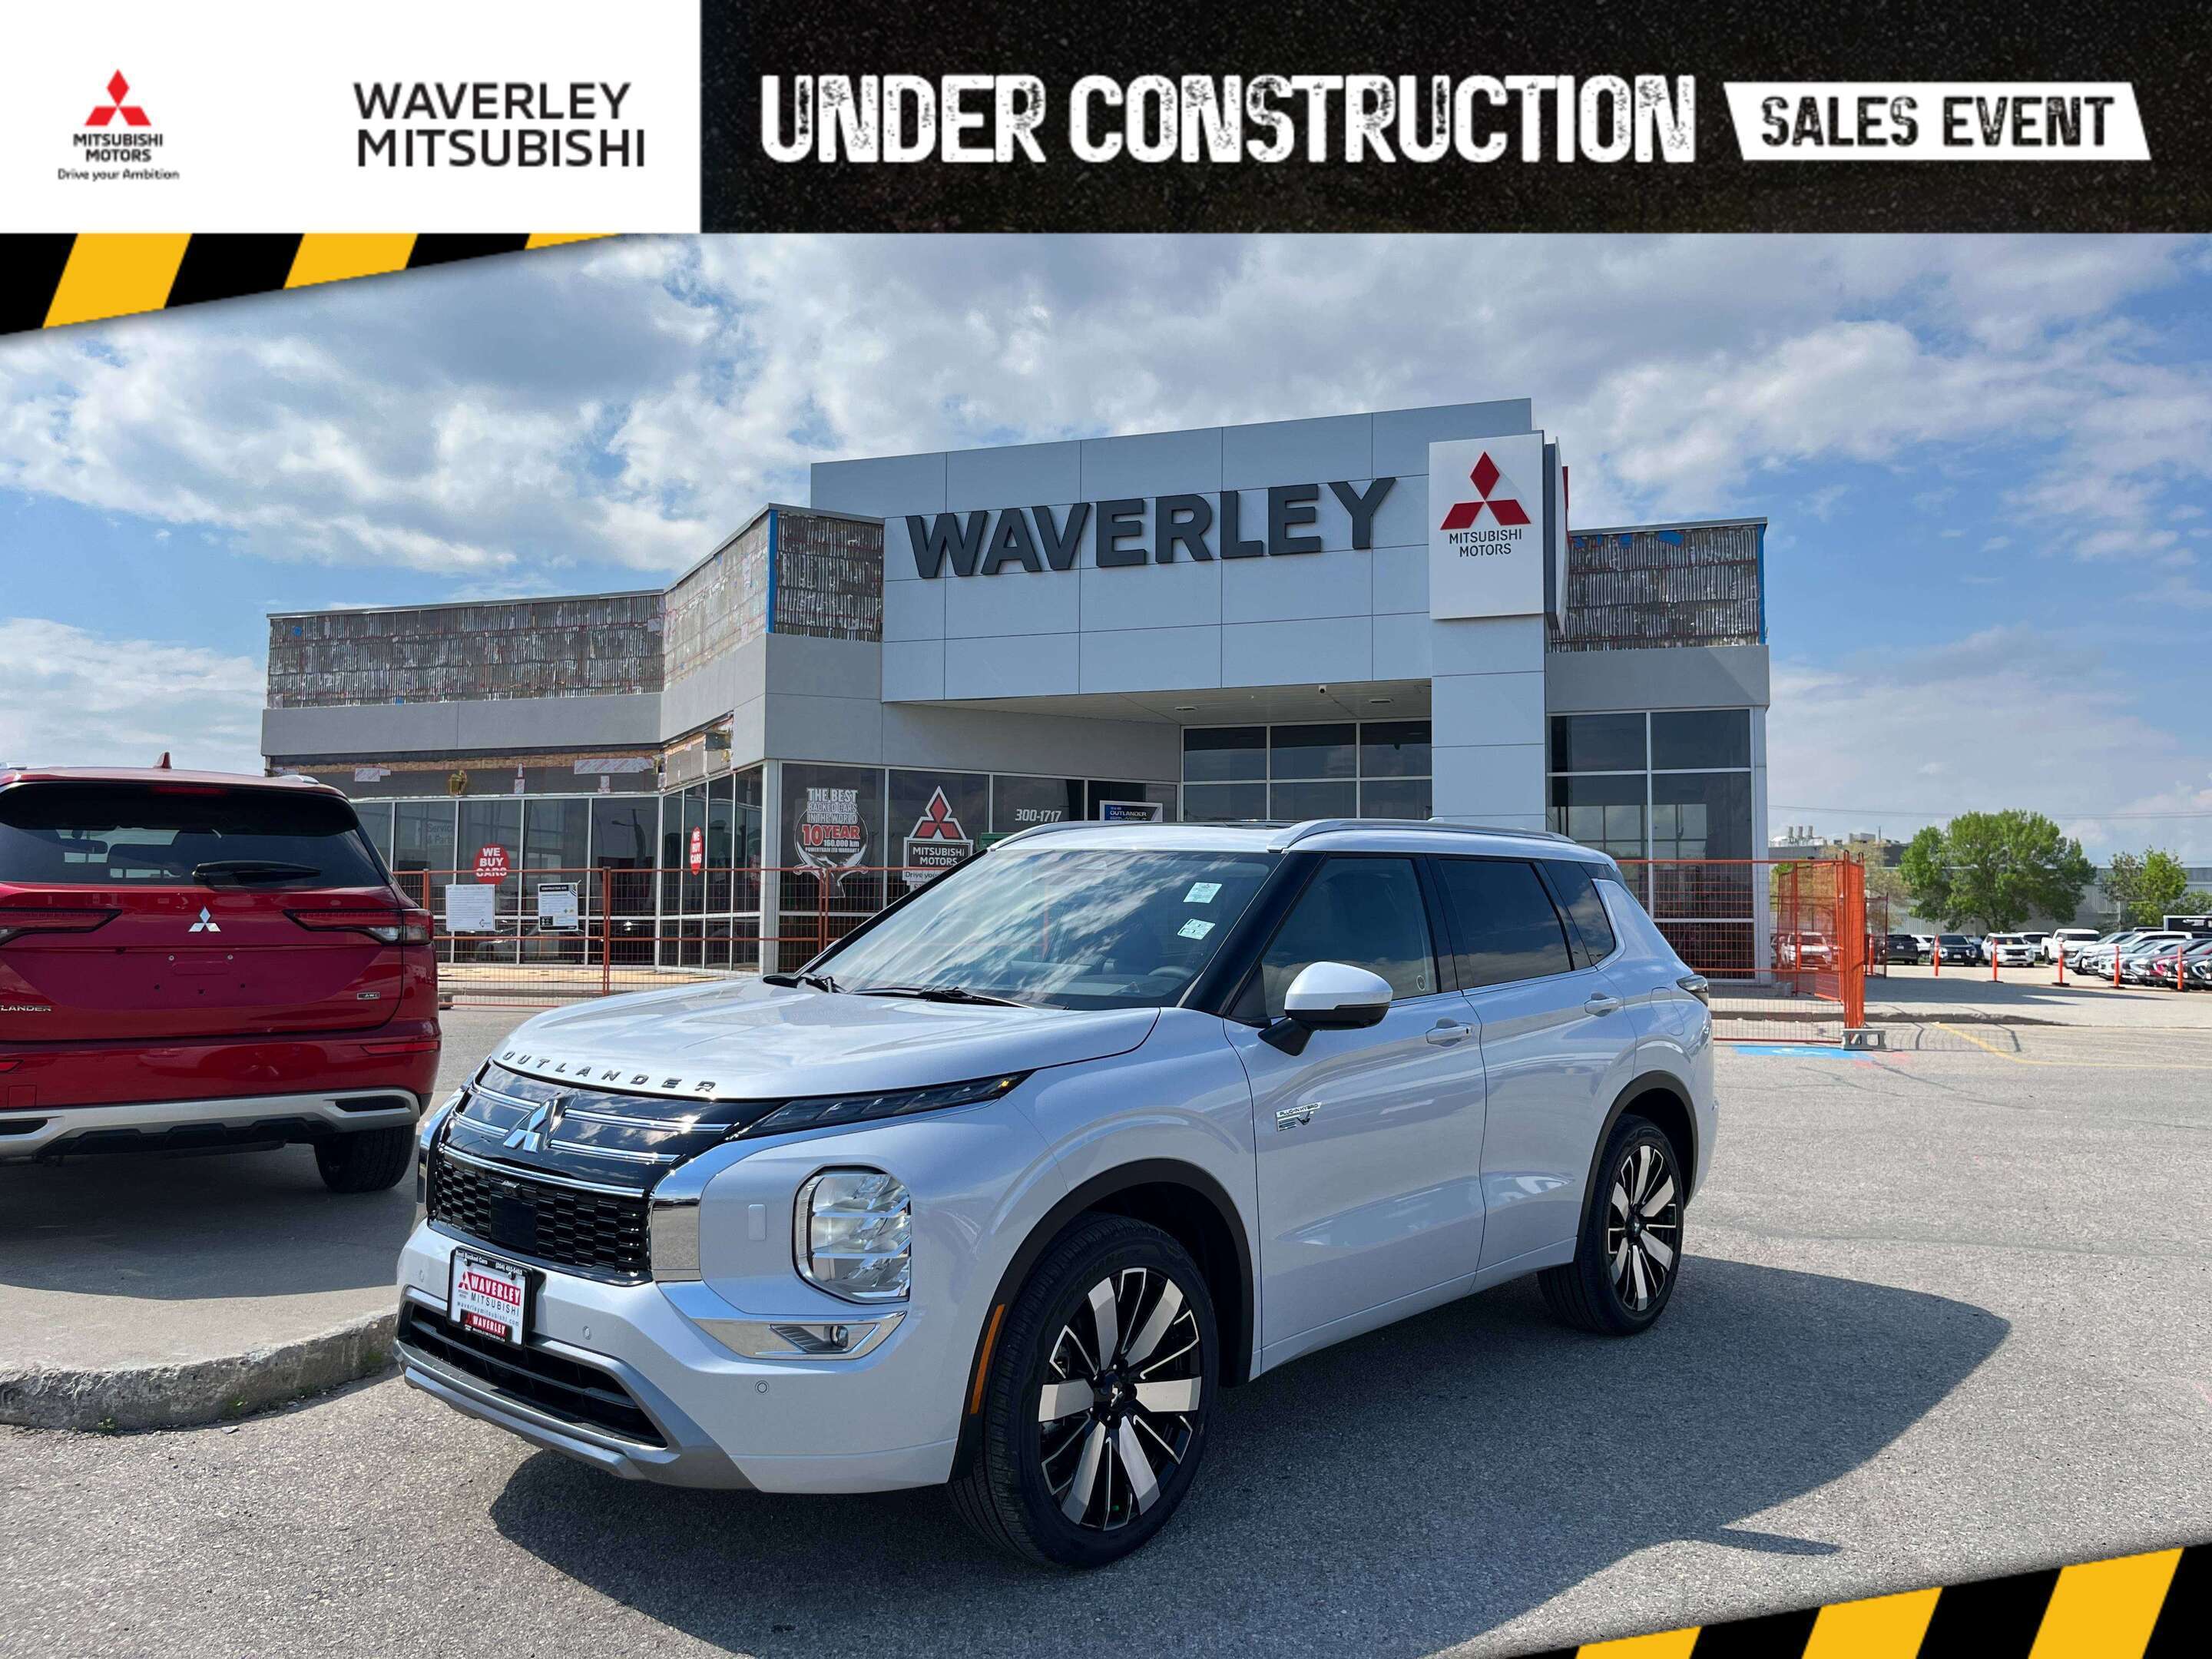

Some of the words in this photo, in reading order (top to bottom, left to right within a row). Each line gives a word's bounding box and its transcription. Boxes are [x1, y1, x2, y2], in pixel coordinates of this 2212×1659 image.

[906, 477, 1396, 579] WAVERLEY
[1449, 528, 1522, 545] MITSUBISHI
[1459, 543, 1512, 558] MOTORS
[807, 788, 828, 802] THE
[830, 790, 858, 803] BEST
[808, 802, 836, 813] BACKED
[837, 803, 858, 813] CARS
[807, 813, 816, 823] IN
[816, 813, 830, 823] THE
[830, 813, 858, 824] WORLD
[1015, 808, 1062, 823] 300-1717
[802, 824, 824, 846] 10
[822, 825, 860, 839] YEAR
[482, 847, 501, 857] WE
[912, 846, 965, 856] MITSUBISHI
[479, 857, 504, 867] BUY
[919, 856, 958, 866] MOTORS
[475, 867, 508, 876] CARS
[502, 1050, 717, 1093] OUTLANDER
[471, 1274, 521, 1304] WAVERLEY
[471, 1292, 520, 1317] MITSUBISHI
[472, 1314, 506, 1334] WAVERLEY
